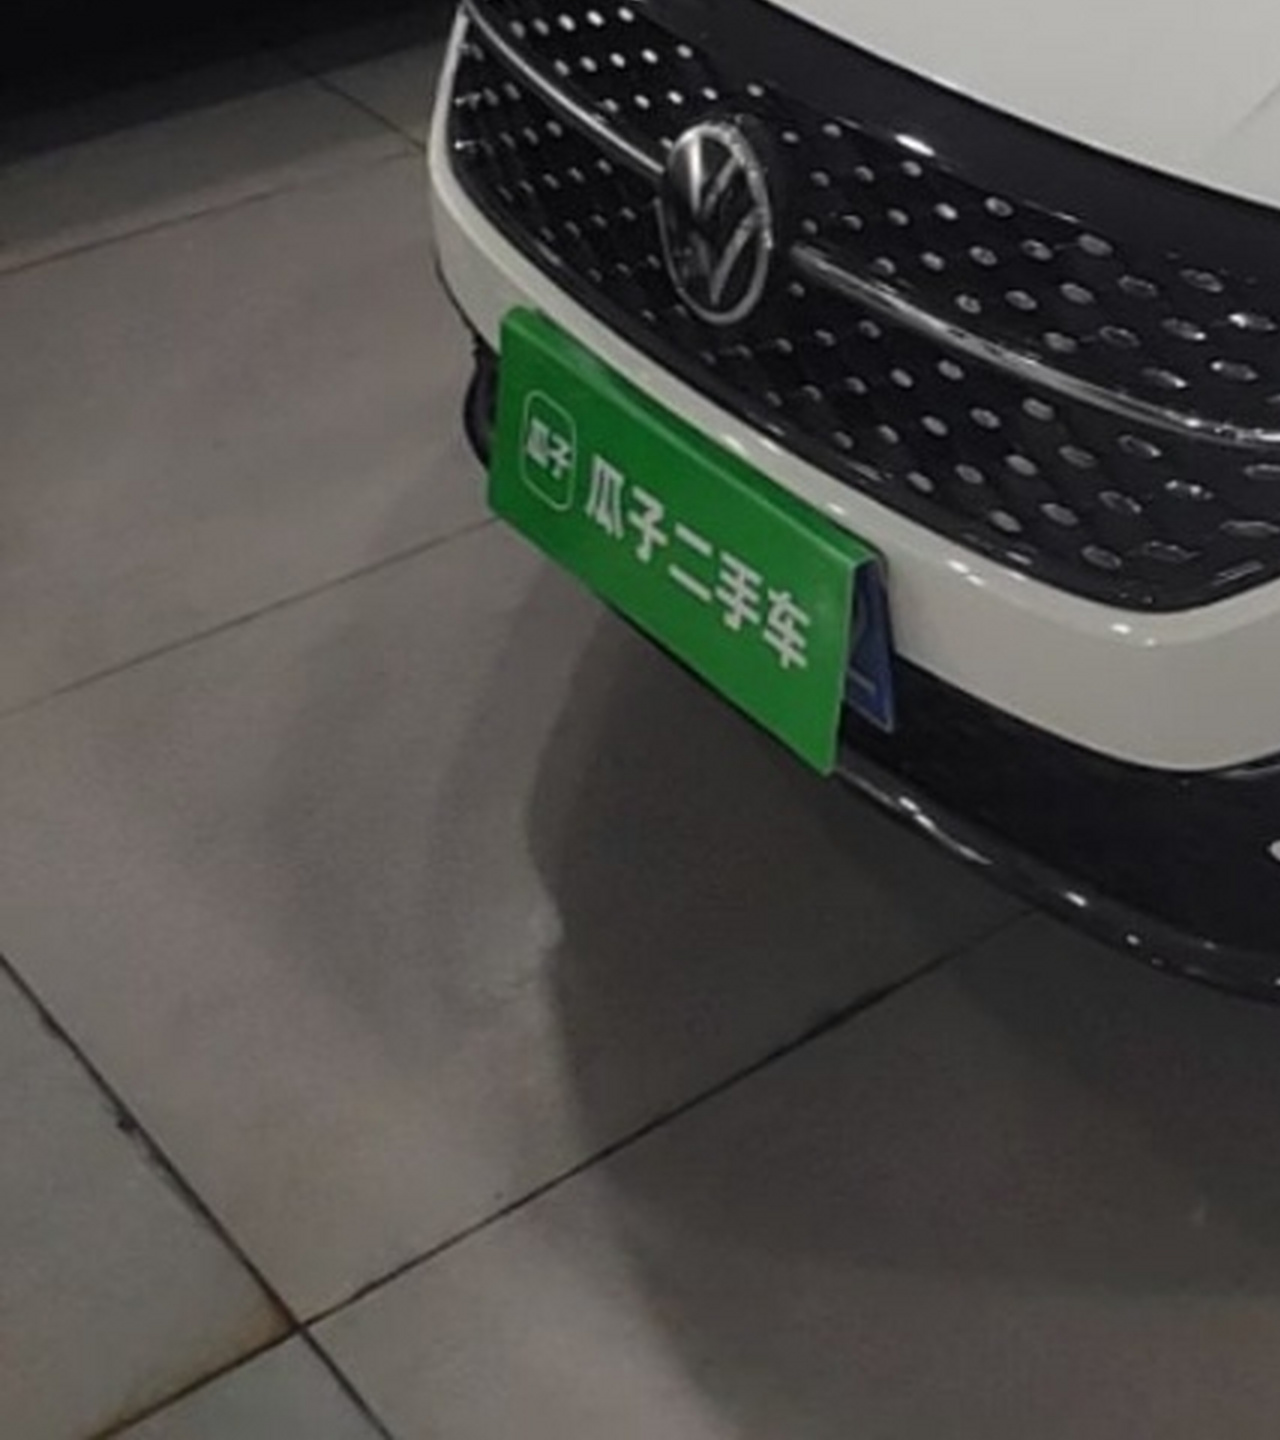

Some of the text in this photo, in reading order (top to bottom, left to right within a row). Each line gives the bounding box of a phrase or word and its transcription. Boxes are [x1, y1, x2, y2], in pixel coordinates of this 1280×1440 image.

[586, 454, 811, 668] 瓜子二手车
